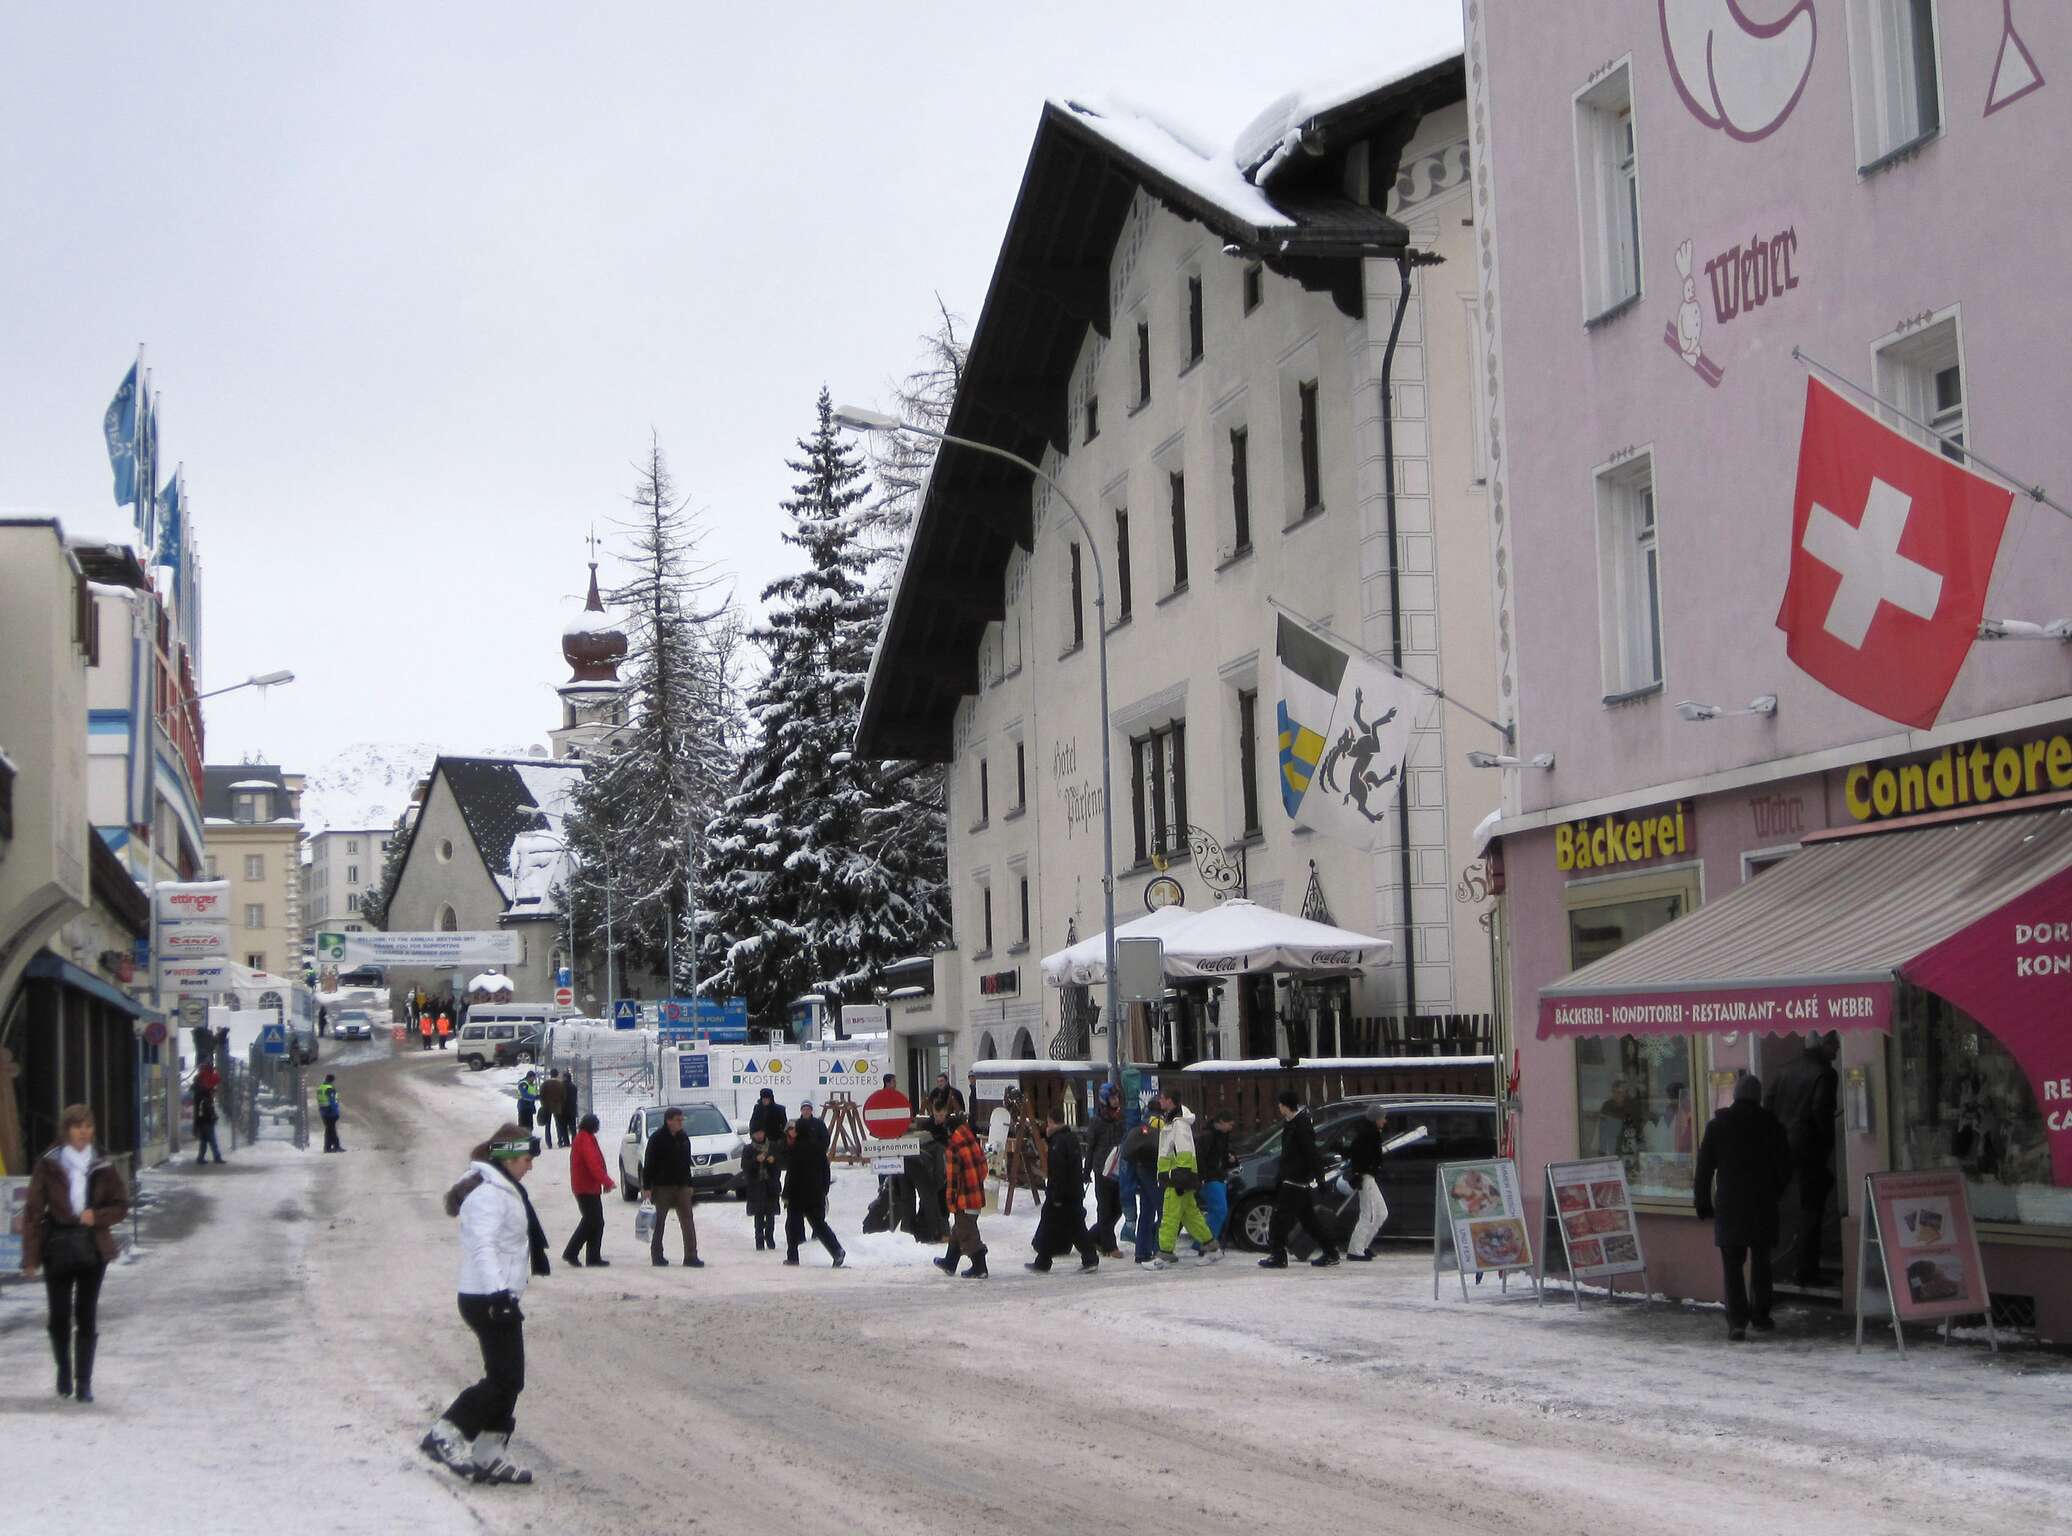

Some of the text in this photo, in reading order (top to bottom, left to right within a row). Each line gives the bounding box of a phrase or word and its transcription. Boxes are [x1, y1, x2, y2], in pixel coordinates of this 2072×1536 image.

[1704, 225, 1799, 325] Weber
[1053, 735, 1077, 786] Hotel
[1555, 801, 1690, 873] Bäckerei
[169, 893, 218, 912] ettinger
[2016, 922, 2072, 945] DOR
[174, 968, 223, 976] INTERSPORT
[1555, 1003, 1604, 1025] BÄCKEREI
[1612, 1004, 1683, 1023] KONDITOREI
[1692, 1001, 1776, 1022] RESTAURANT
[1785, 994, 1819, 1019] CAFÉ
[1828, 997, 1873, 1017] WEBER
[732, 1058, 793, 1073] DAVOS
[818, 1059, 879, 1073] DAVOS
[742, 1075, 792, 1085] KLOSTERS
[828, 1075, 879, 1086] KLOSTERS
[864, 1143, 918, 1152] ausgenommen
